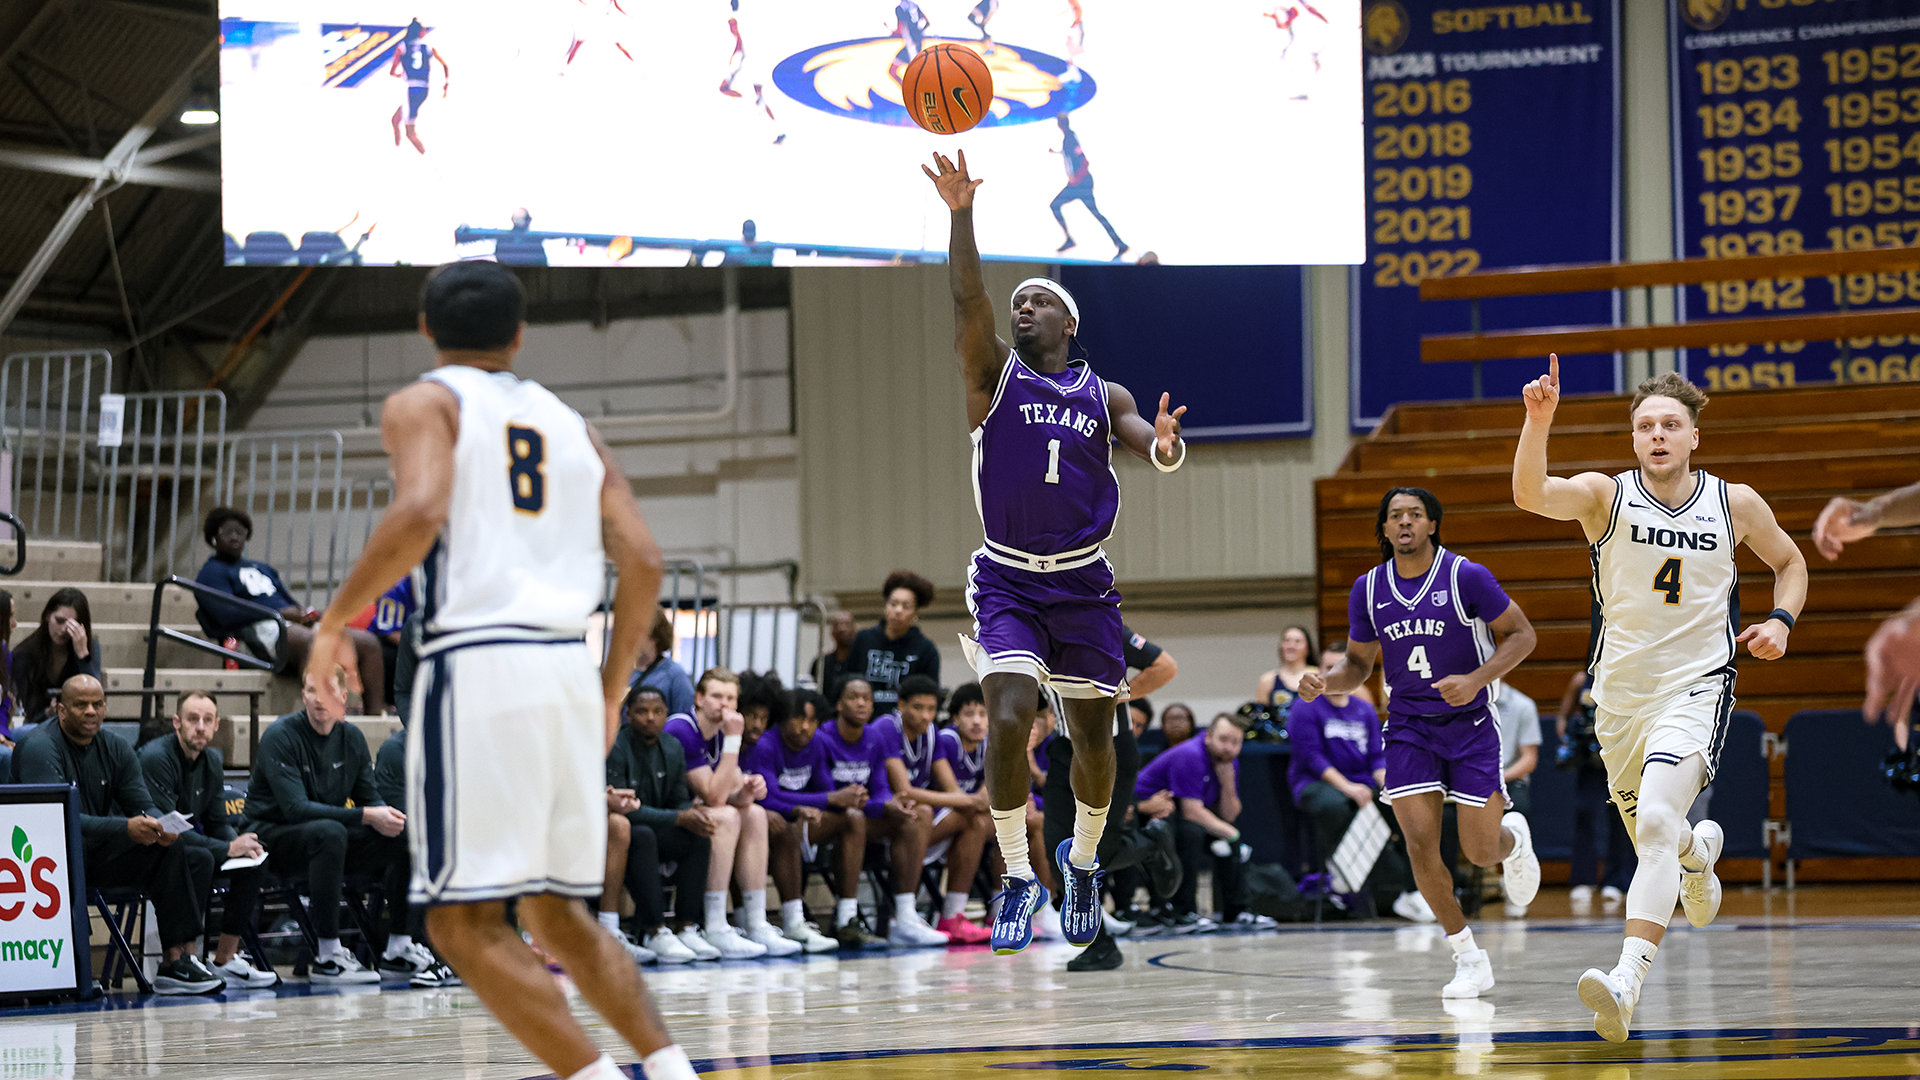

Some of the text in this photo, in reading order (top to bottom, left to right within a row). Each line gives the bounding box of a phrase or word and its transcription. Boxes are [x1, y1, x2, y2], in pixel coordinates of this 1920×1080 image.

[1432, 2, 1593, 34] SOFTBALL
[1441, 44, 1601, 72] TOURNAMENT
[1697, 54, 1800, 95] 1933
[1822, 43, 1920, 85] 1952
[1372, 78, 1473, 117] 2016
[1824, 87, 1920, 129] 1953
[1698, 97, 1802, 139] 1934
[1372, 121, 1472, 161] 2018
[1699, 141, 1803, 182] 1935
[1372, 163, 1473, 203] 2019
[1373, 205, 1472, 245] 2021
[1700, 184, 1803, 226] 1937
[1373, 248, 1482, 288] 2022
[1701, 277, 1806, 314] 1942
[1019, 403, 1098, 438] TEXANS
[506, 422, 547, 516] 8
[1044, 438, 1061, 485] 1
[1630, 524, 1718, 551] LIONS
[1651, 556, 1684, 606] 4
[1383, 618, 1445, 641] TEXANS
[1407, 645, 1433, 679] 4
